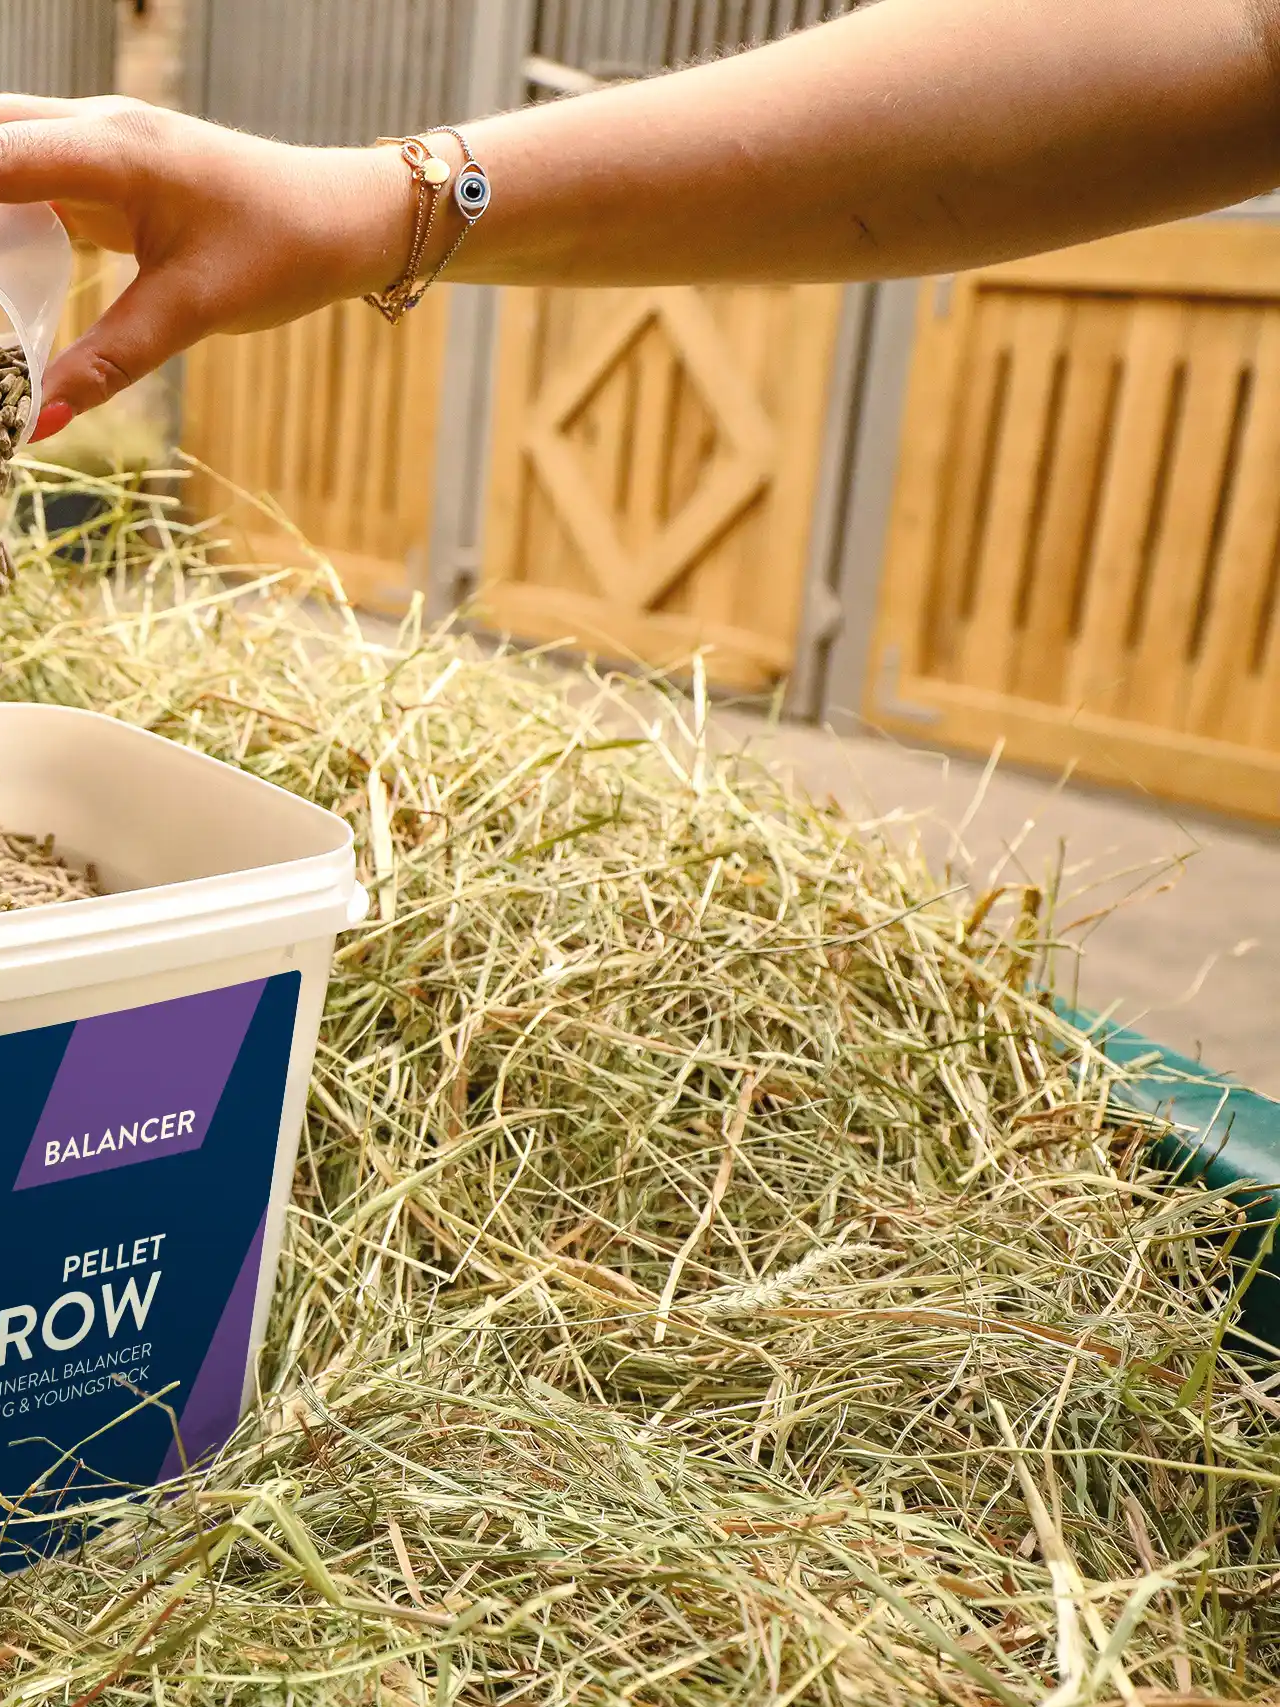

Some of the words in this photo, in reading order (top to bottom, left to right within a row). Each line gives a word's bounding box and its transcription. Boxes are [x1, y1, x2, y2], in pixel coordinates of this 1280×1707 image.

[43, 1109, 196, 1167] BALANCER
[62, 1233, 167, 1283] PELLET
[63, 1342, 152, 1379] BALANCER
[19, 1397, 30, 1414] &
